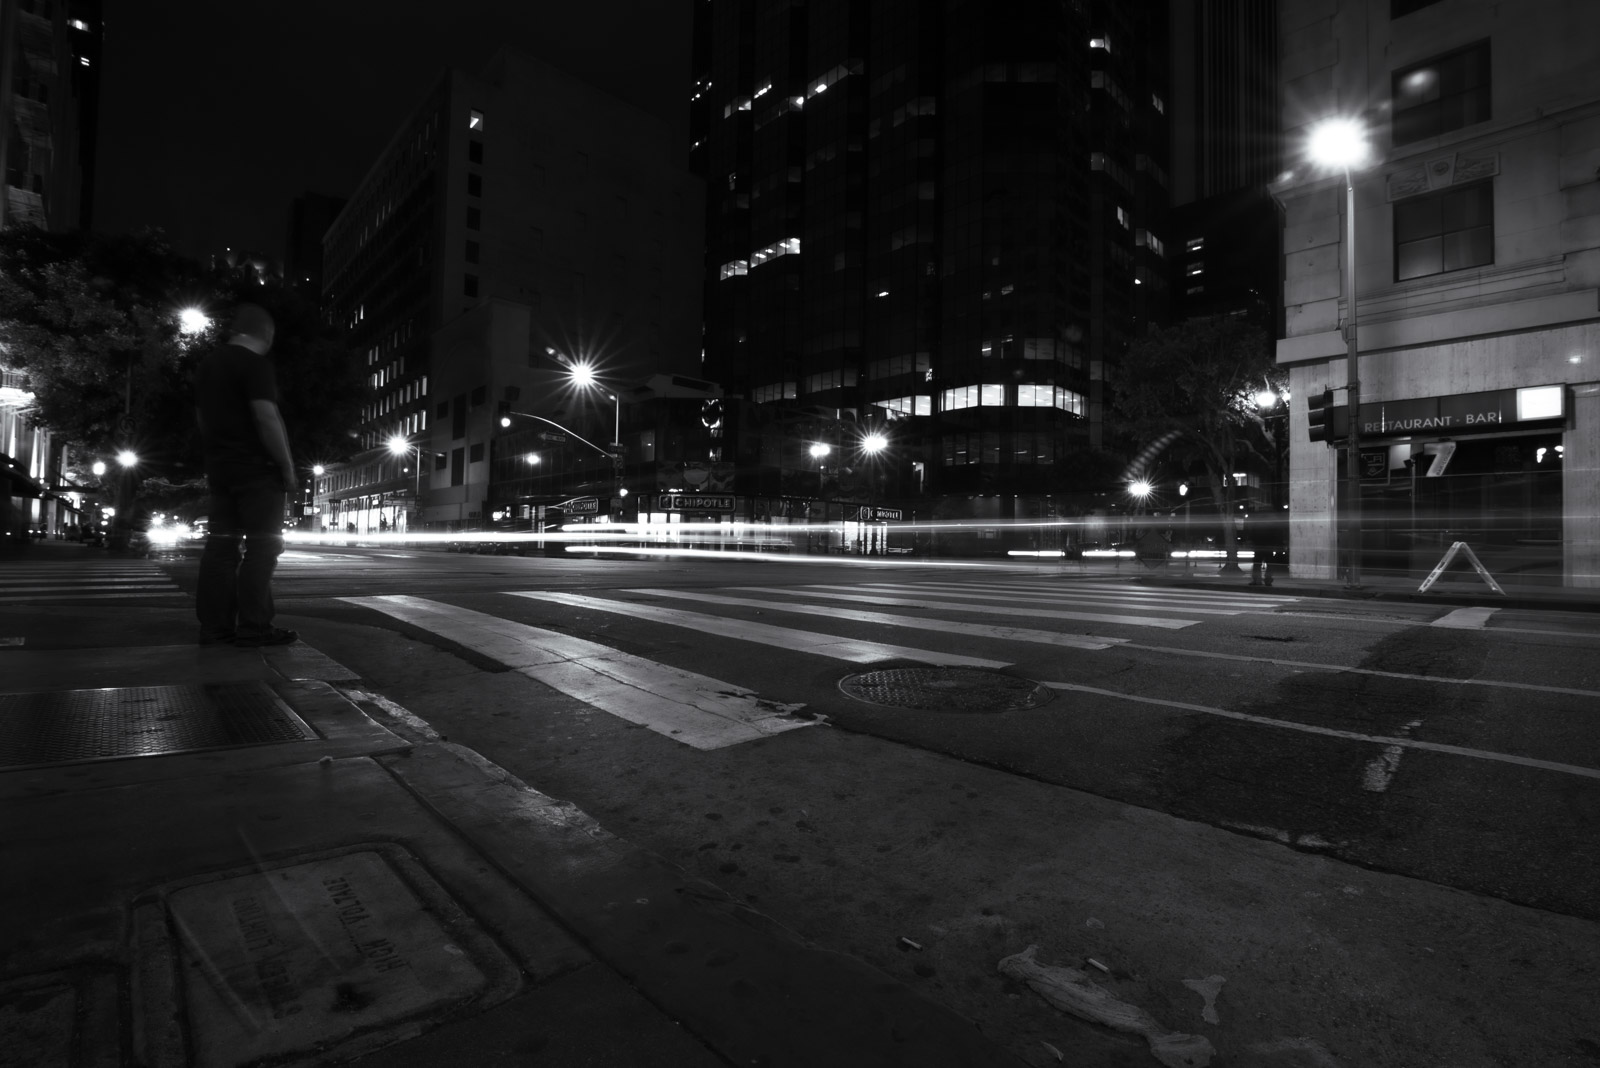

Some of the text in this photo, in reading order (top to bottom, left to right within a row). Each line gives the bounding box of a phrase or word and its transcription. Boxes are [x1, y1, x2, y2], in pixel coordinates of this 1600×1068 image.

[1364, 411, 1498, 433] RESTAURANT BAR
[675, 497, 732, 509] CHIPOTLE
[322, 877, 410, 973] HIGH VOLTAGE
